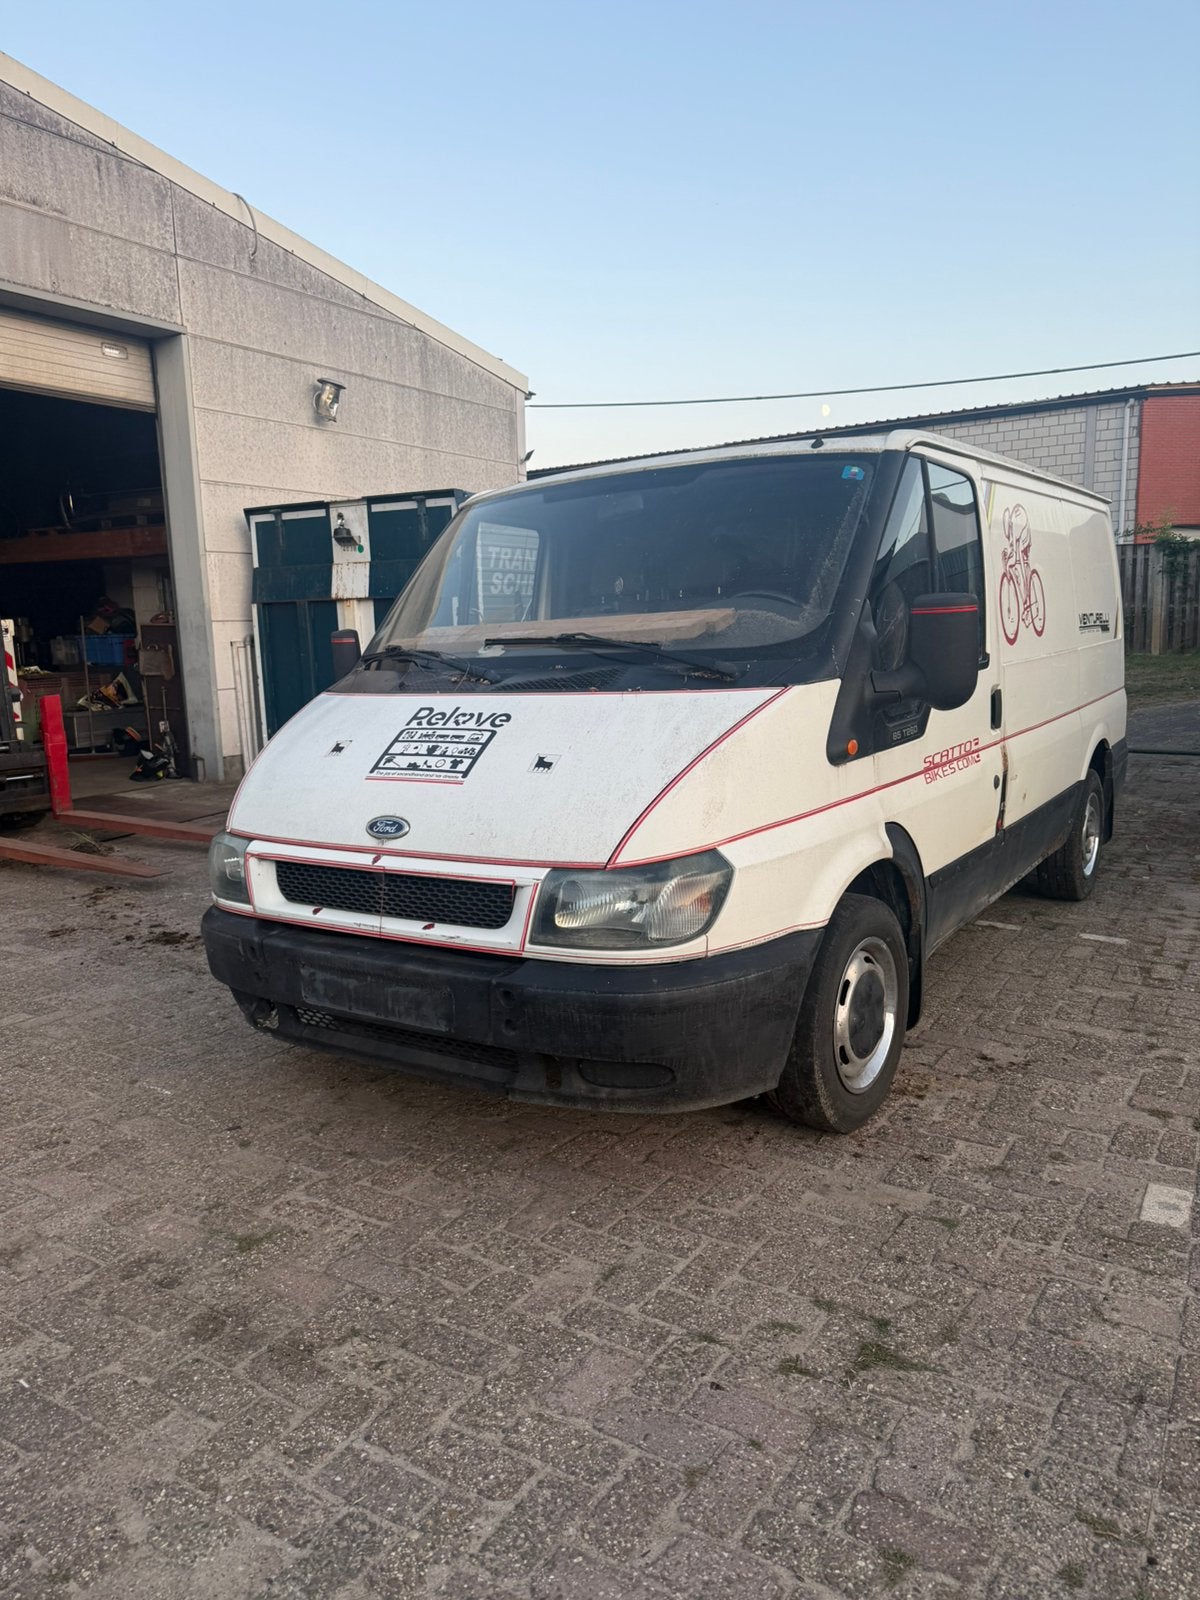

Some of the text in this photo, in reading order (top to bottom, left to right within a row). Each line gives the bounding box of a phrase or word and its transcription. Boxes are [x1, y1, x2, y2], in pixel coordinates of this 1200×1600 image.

[405, 706, 512, 728] Relove
[923, 740, 973, 768] SCATTO
[924, 763, 956, 784] BIKES
[373, 819, 398, 833] Ford
